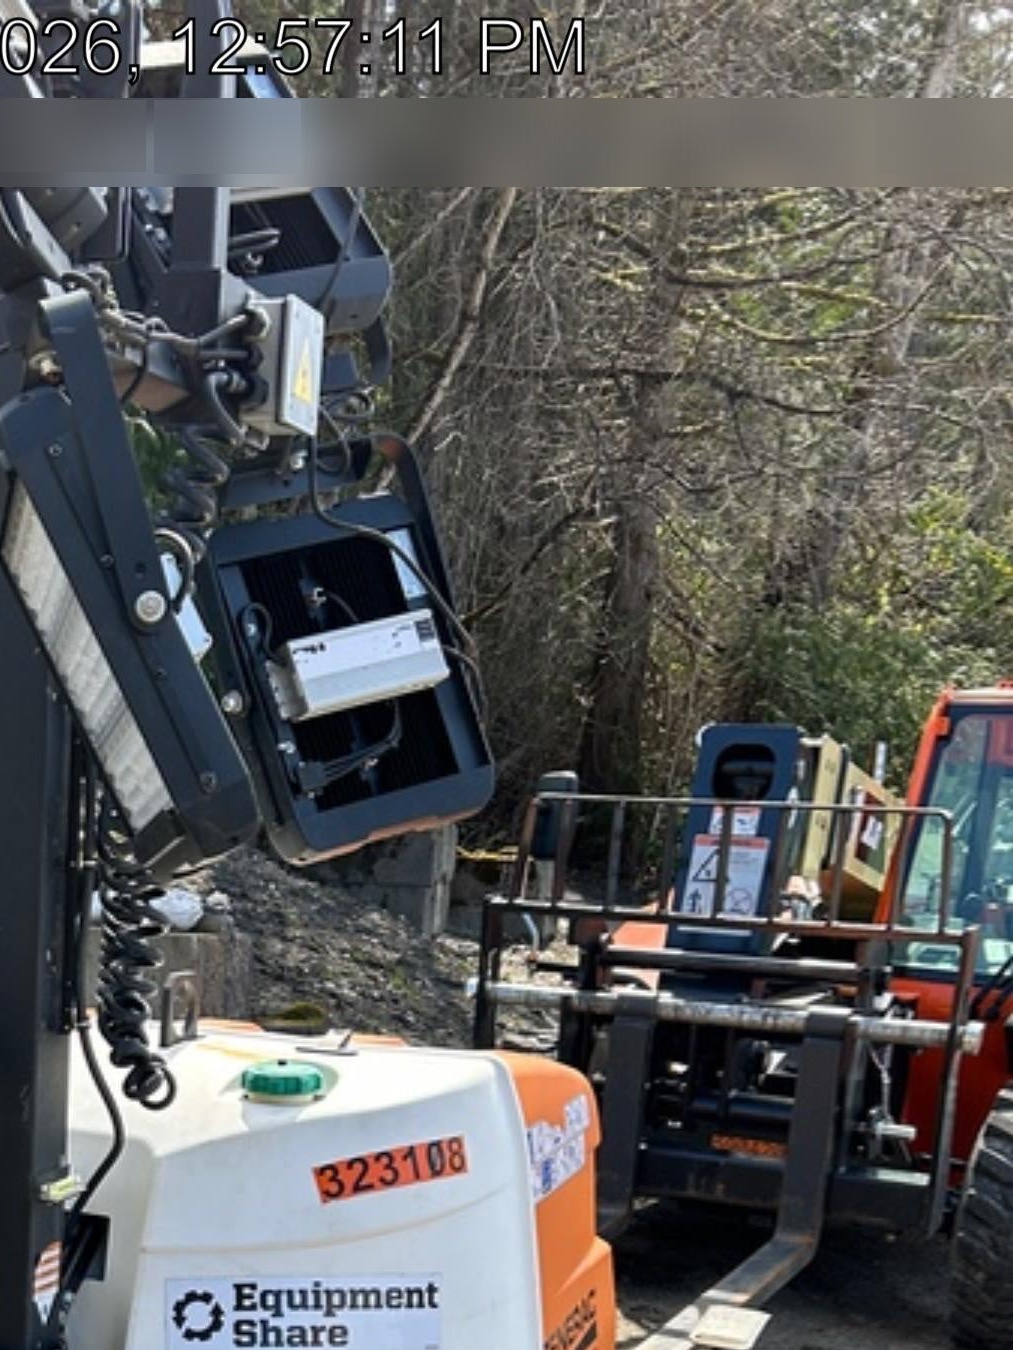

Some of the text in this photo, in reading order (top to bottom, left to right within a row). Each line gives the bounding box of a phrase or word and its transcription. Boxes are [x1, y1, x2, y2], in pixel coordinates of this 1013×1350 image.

[319, 1137, 465, 1199] 323108
[232, 1281, 439, 1318] Equipment
[232, 1319, 349, 1348] Share
